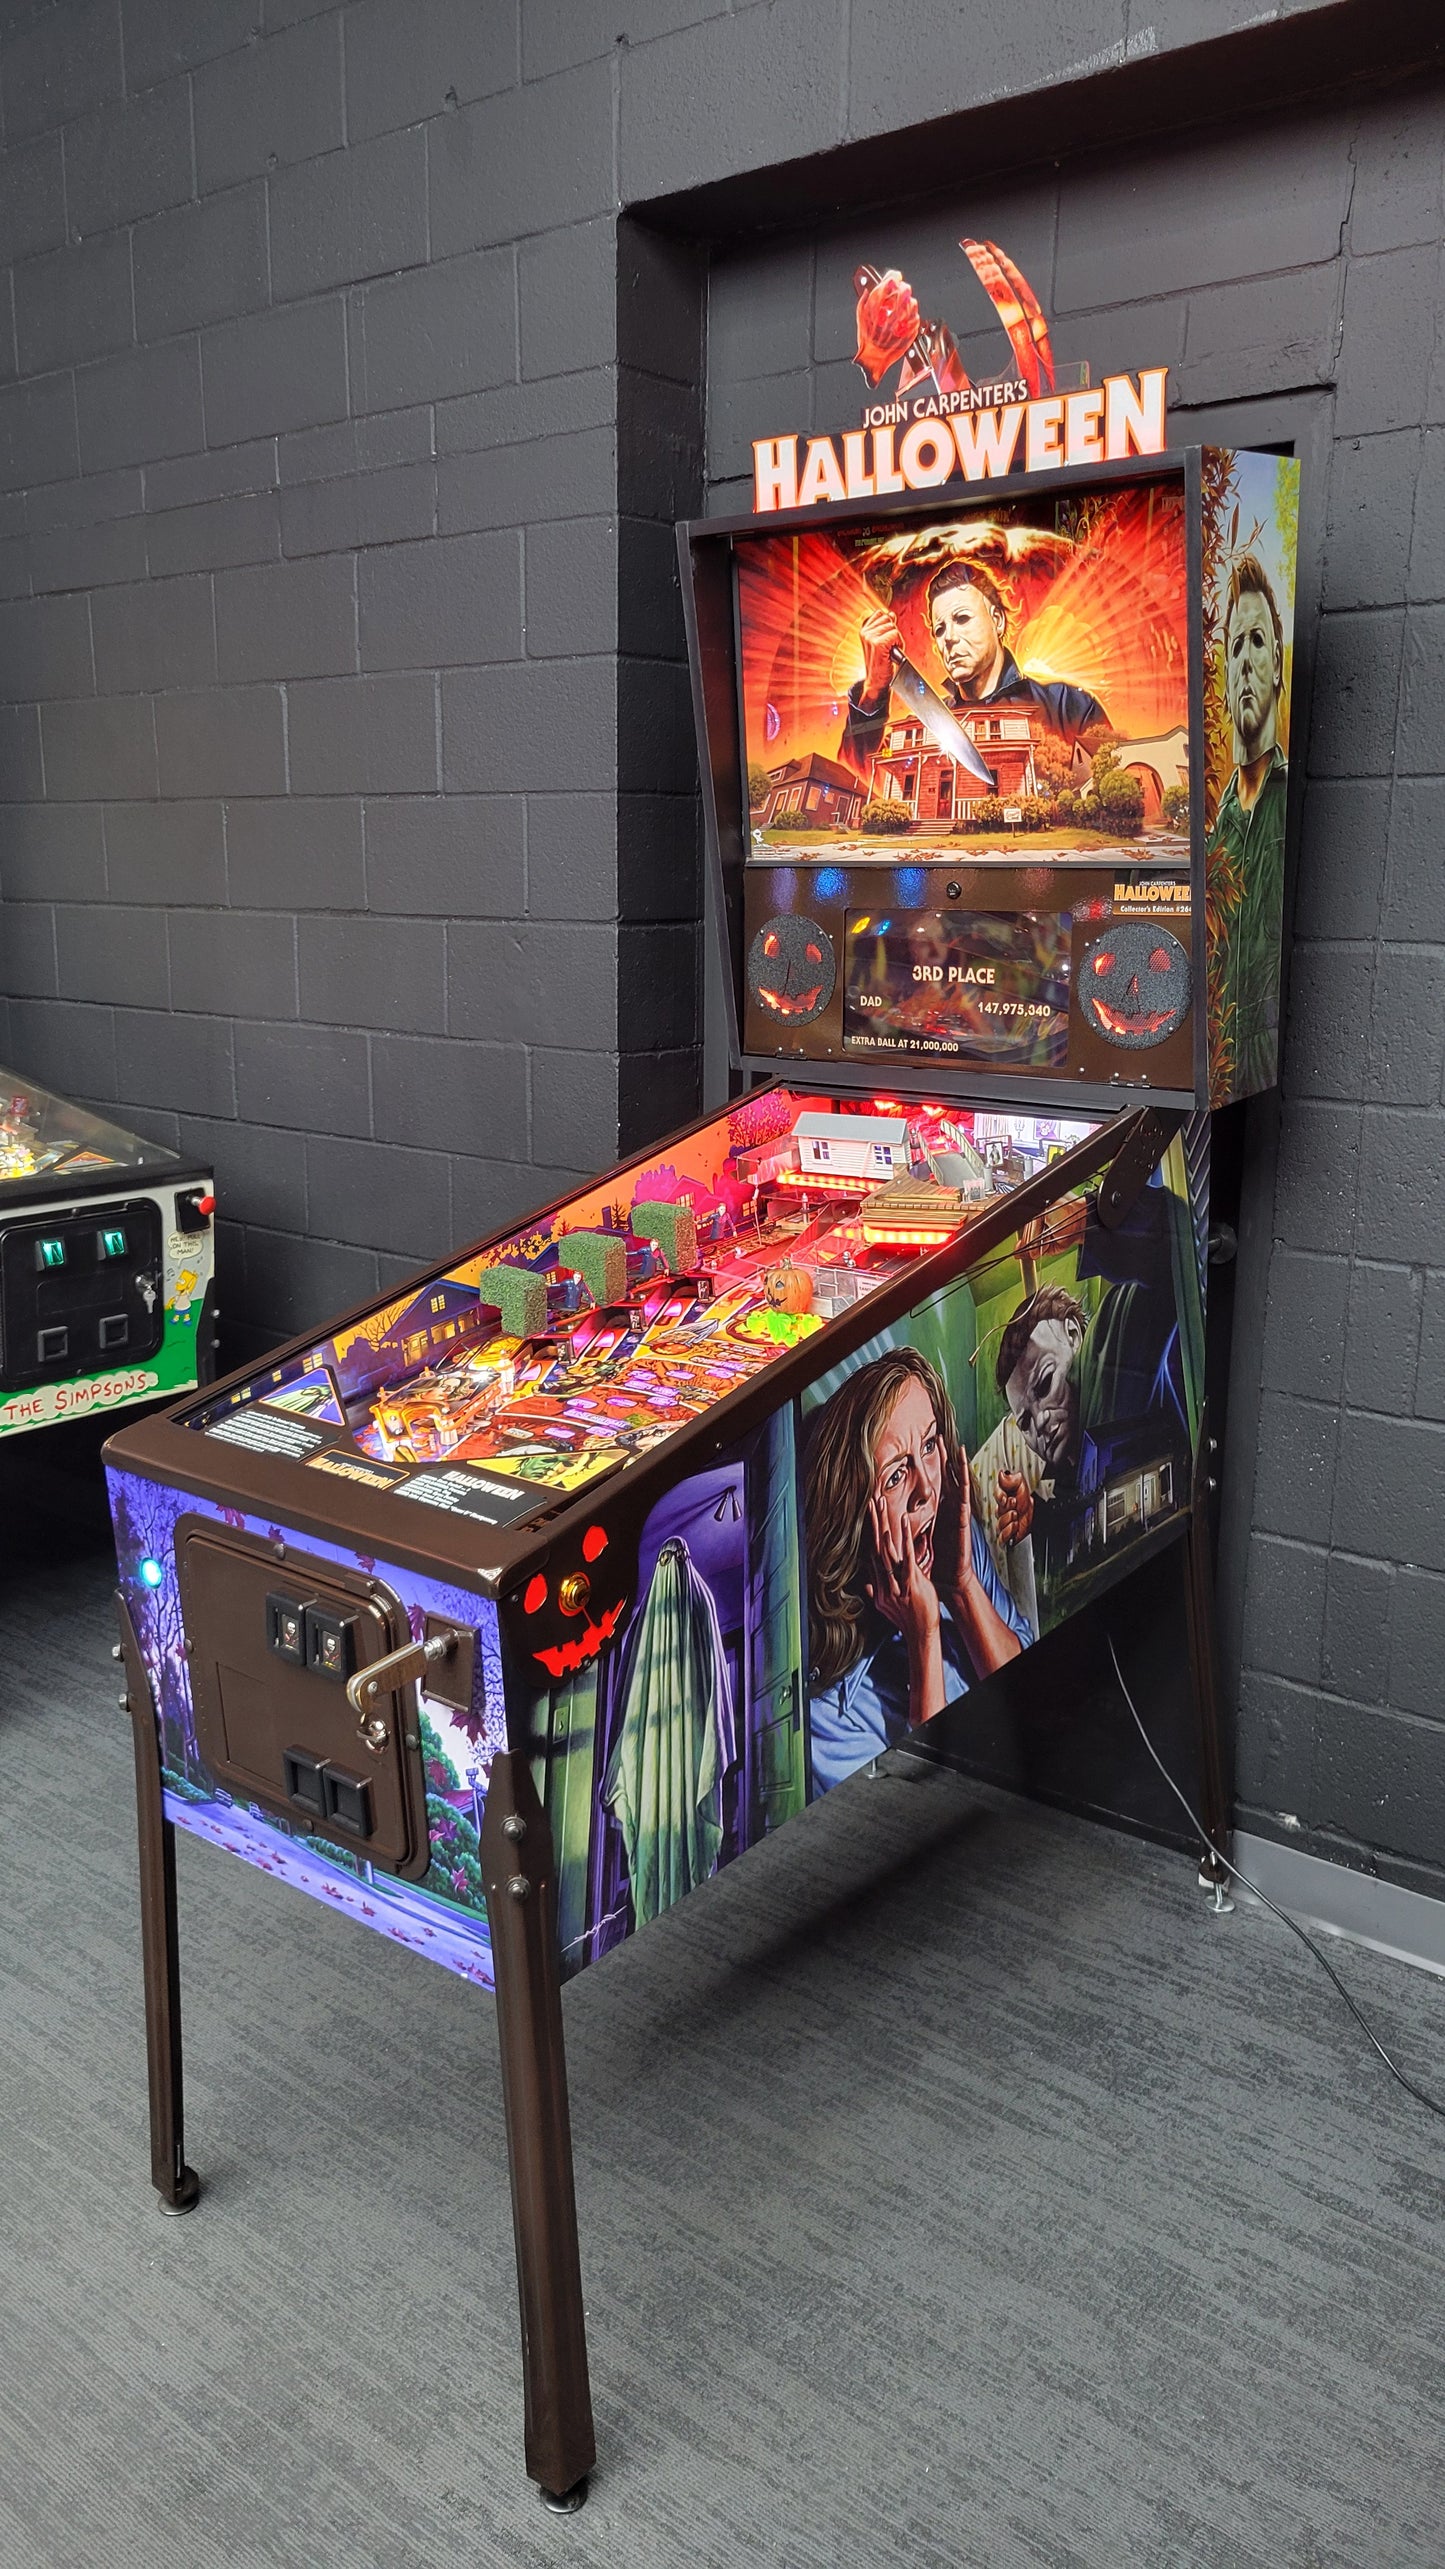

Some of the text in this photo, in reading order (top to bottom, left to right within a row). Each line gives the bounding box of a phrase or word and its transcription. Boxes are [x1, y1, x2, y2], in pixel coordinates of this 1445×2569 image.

[863, 379, 1028, 428] JOHN CARPENTER'S
[753, 367, 1168, 513] HALLOWEEN
[1114, 883, 1191, 901] HALLOWEE
[1120, 905, 1151, 913] Collector's
[1153, 905, 1174, 913] Edition
[912, 965, 996, 985] 3RD PLACE
[860, 995, 1051, 1017] DAD 147,975,340
[851, 1036, 959, 1052] EXTRA BALL AT 21,000,000
[3, 1373, 147, 1420] THE SIMPSONS
[442, 1470, 525, 1501] HALLOWEEN
